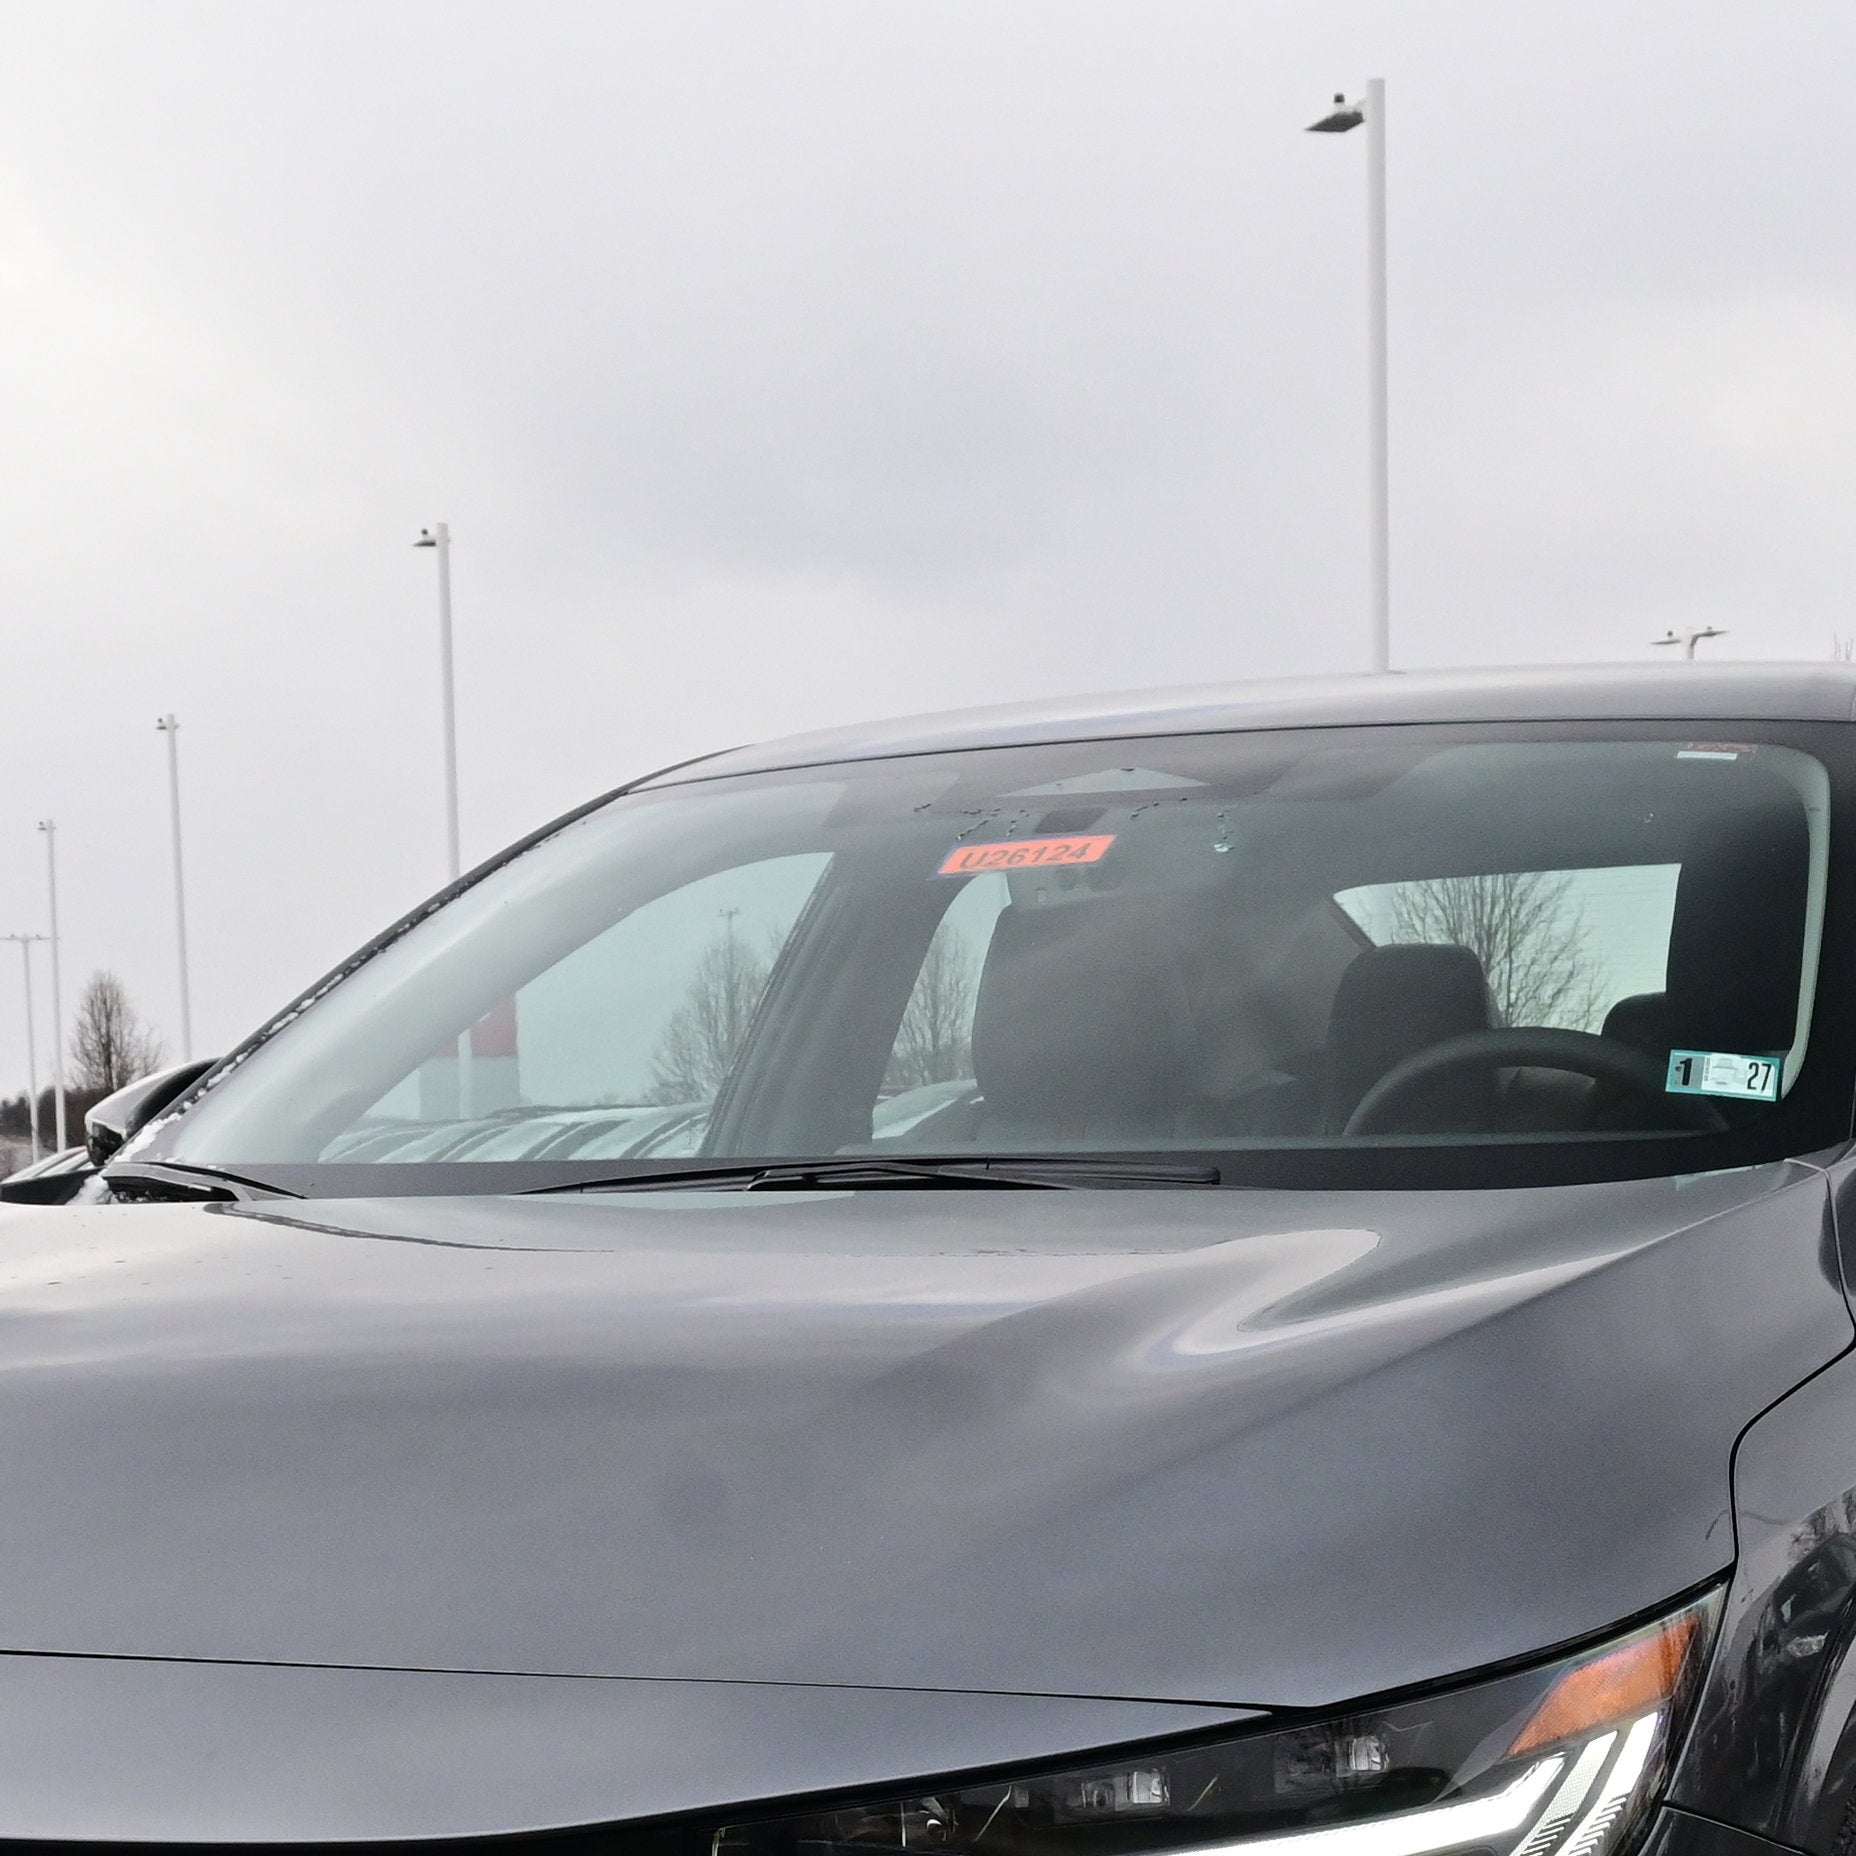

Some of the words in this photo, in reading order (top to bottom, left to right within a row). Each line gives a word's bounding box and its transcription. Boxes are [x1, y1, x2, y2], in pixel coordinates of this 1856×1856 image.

[959, 842, 1092, 869] U26124
[1679, 1057, 1693, 1086] 1
[1746, 1062, 1772, 1092] 27
